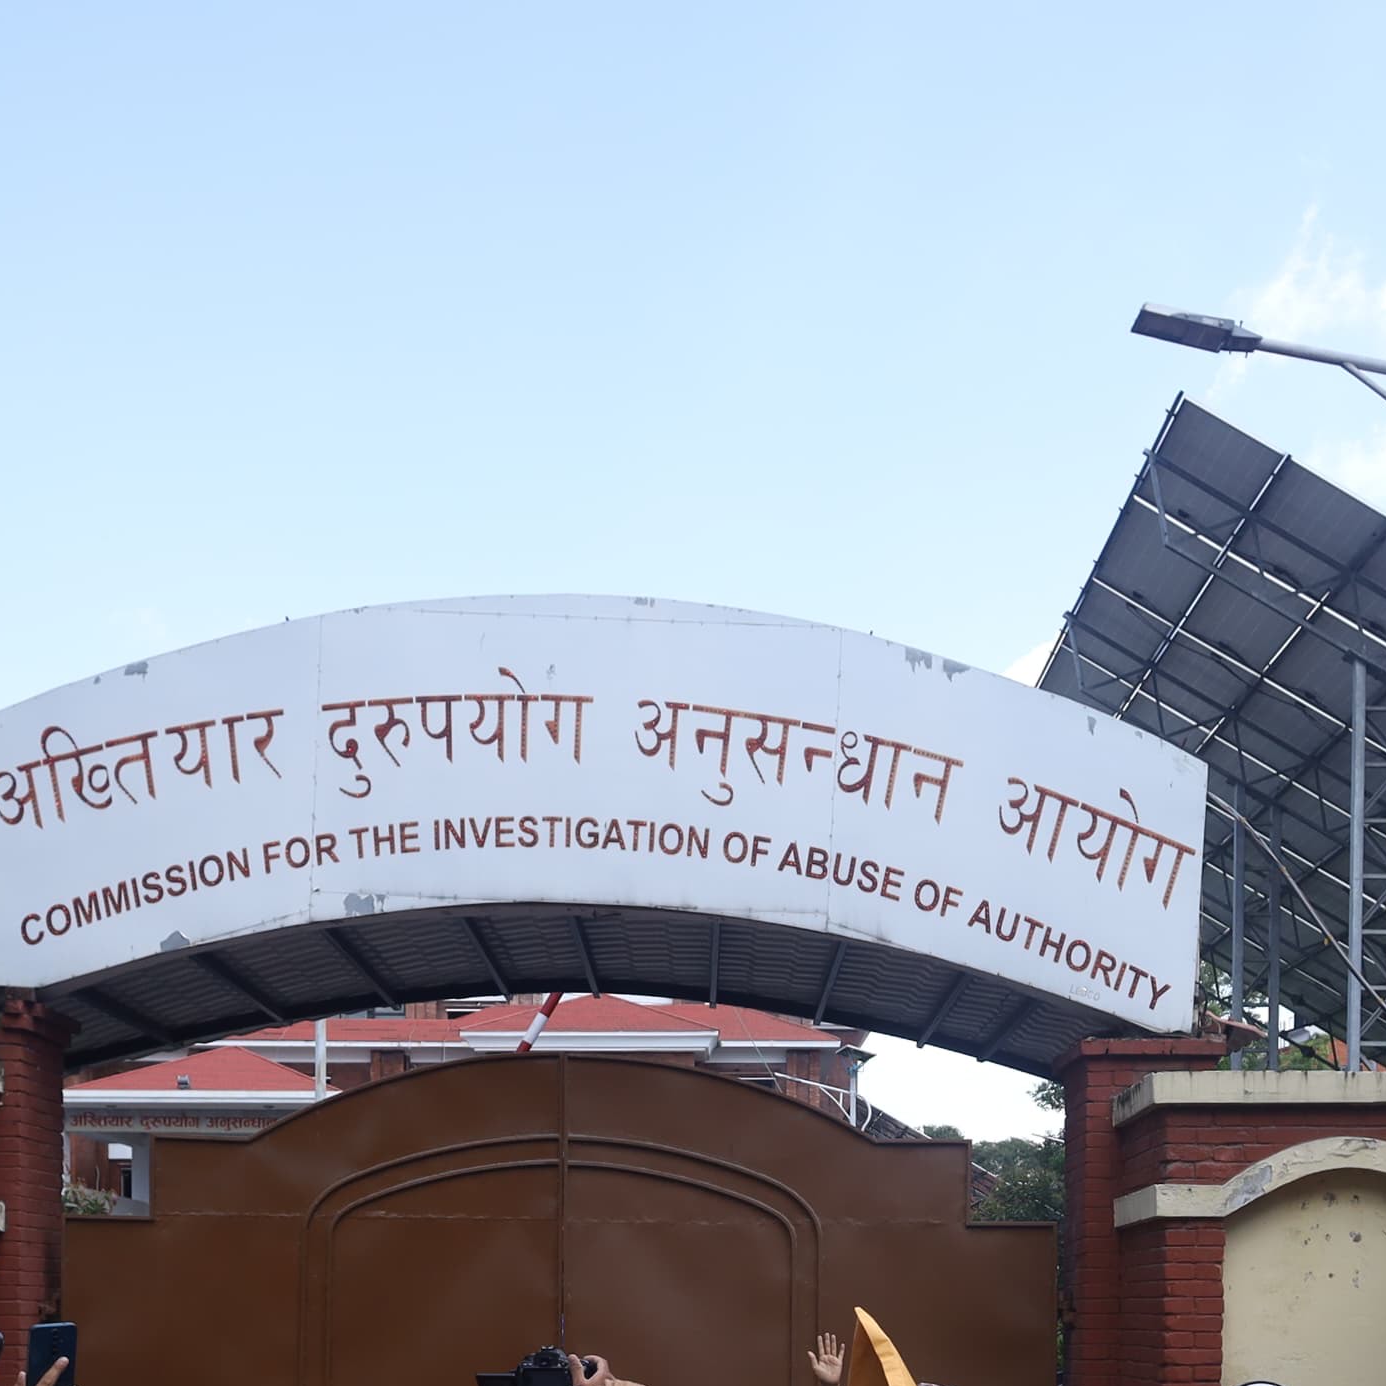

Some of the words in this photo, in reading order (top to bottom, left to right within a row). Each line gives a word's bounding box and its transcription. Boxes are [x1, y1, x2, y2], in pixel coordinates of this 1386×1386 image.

[321, 666, 595, 799] दुरुपयोग
[635, 699, 964, 825] अनुसन्धान
[998, 777, 1196, 910] आयोग
[20, 848, 252, 946] COMMISSION
[263, 833, 340, 874] FOR
[349, 821, 421, 859] THE
[433, 815, 711, 860] INVESTIGATION
[723, 831, 772, 867] OF
[778, 842, 905, 901] ABUSE
[915, 879, 965, 918] OF
[968, 900, 1172, 1011] AUTHORITY
